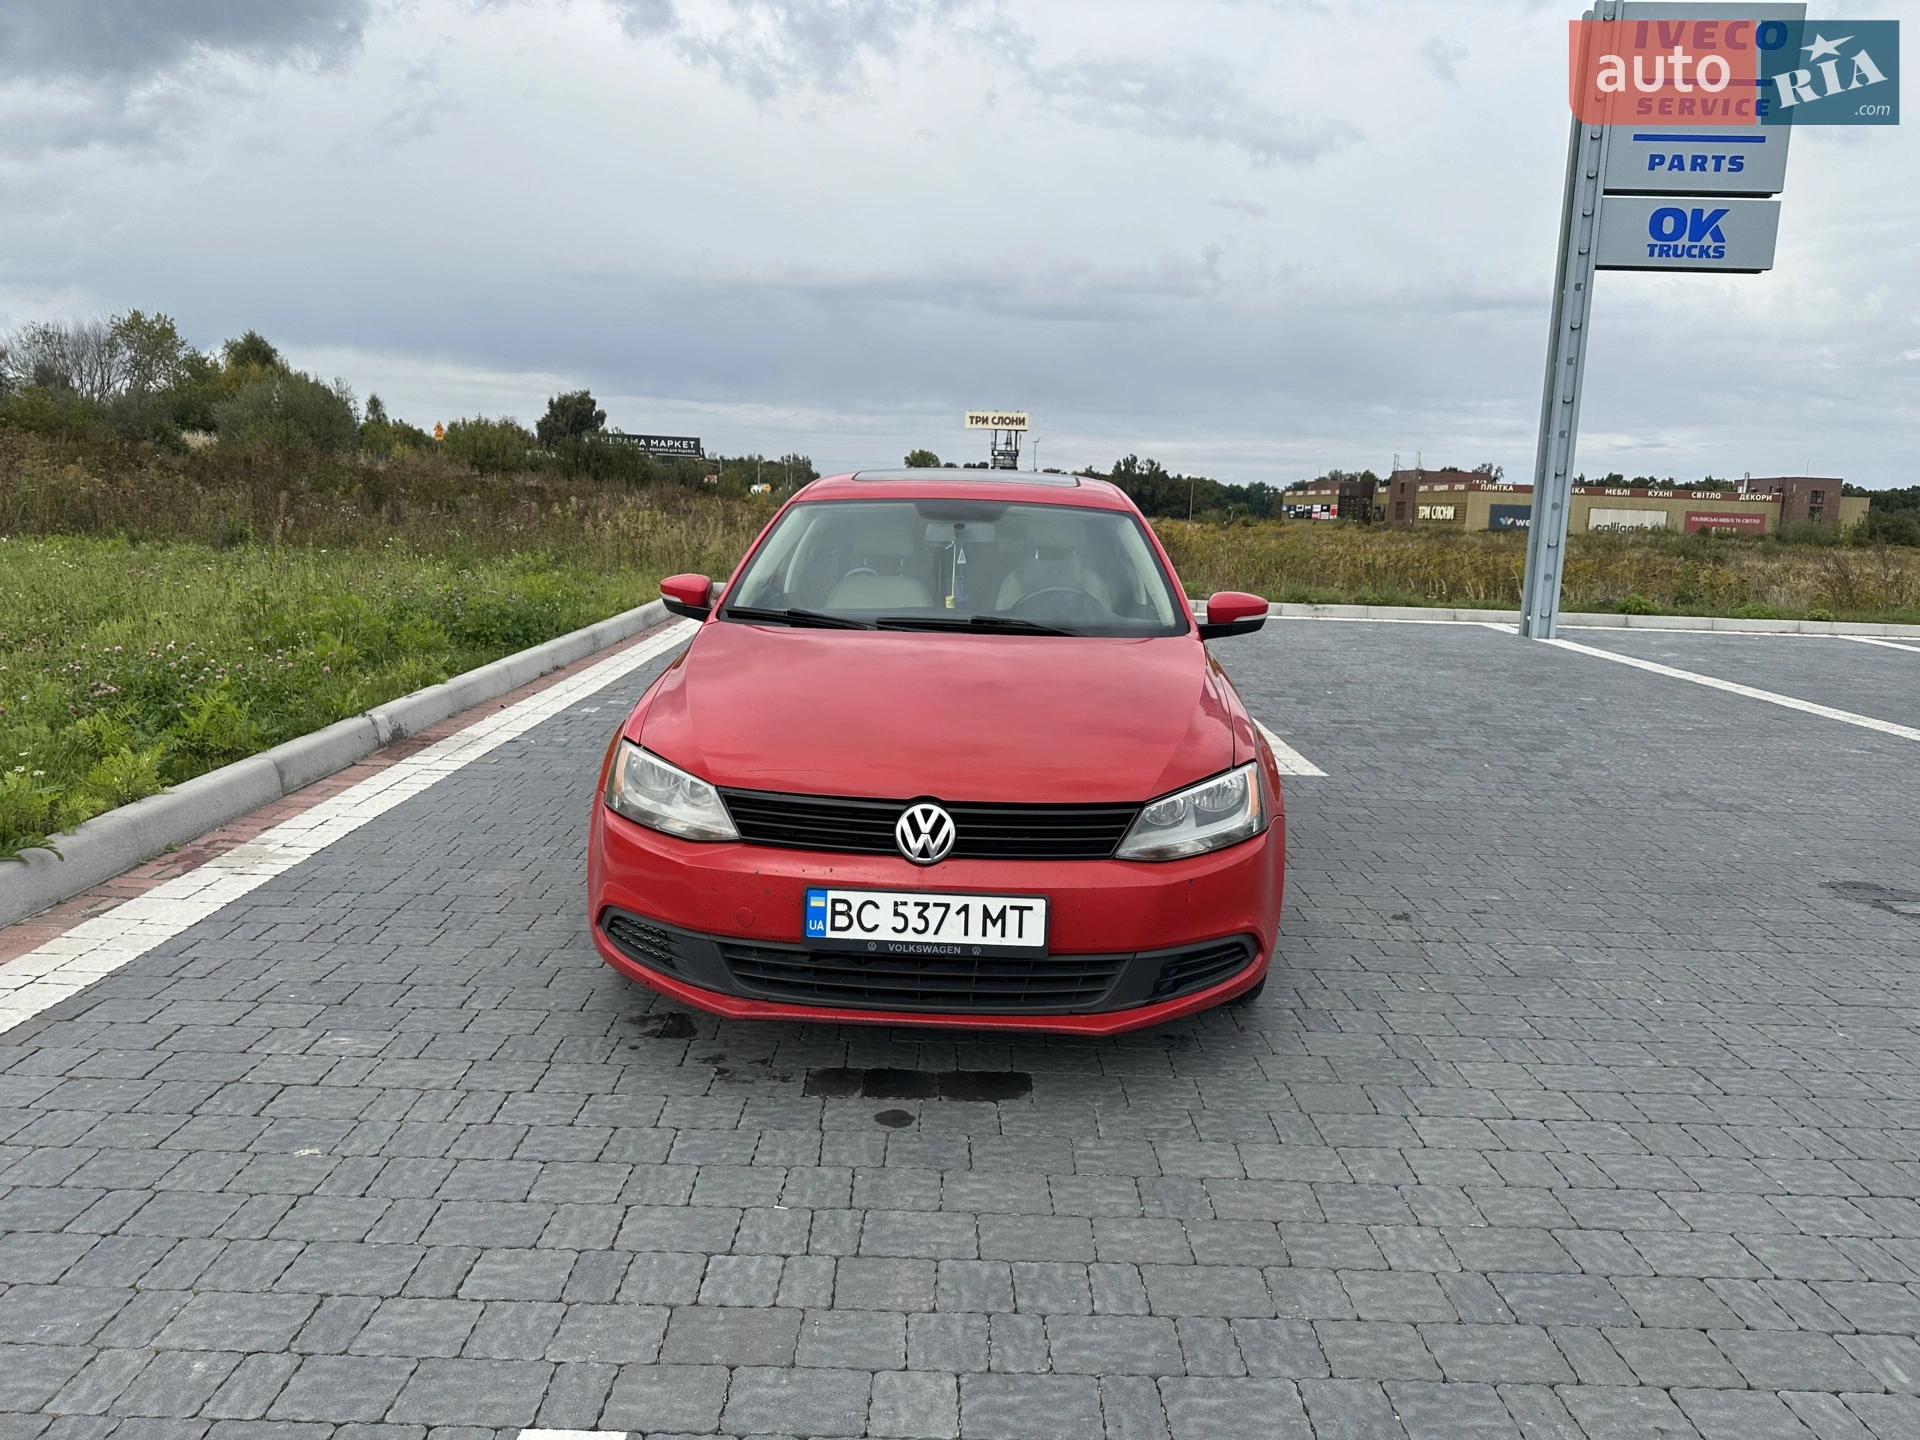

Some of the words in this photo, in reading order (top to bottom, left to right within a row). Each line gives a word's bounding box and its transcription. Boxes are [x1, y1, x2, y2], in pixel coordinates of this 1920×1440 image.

[1634, 20, 1788, 50] IVECO
[1636, 97, 1771, 117] SERVICE
[1648, 153, 1744, 173] PARTS
[1648, 207, 1730, 243] OK
[1647, 243, 1725, 259] TRUCKS
[969, 416, 989, 425] ТРИ
[991, 416, 1026, 426] СЛОНИ
[650, 440, 695, 449] МАРКЕТ
[1480, 484, 1514, 492] ПЛИТКА
[1605, 488, 1630, 496] МЕБЛІ
[1647, 490, 1673, 498] КУХНІ
[1691, 491, 1721, 500] СВІТЛО
[1738, 493, 1773, 502] ДЕКОРИ
[1418, 506, 1431, 519] ТРИ
[1431, 505, 1455, 519] СЛОНИ
[830, 898, 880, 933] BC
[891, 901, 970, 937] 5371
[982, 904, 1034, 939] MT
[809, 919, 825, 931] UA
[888, 943, 961, 955] VOLKSWAGEN
